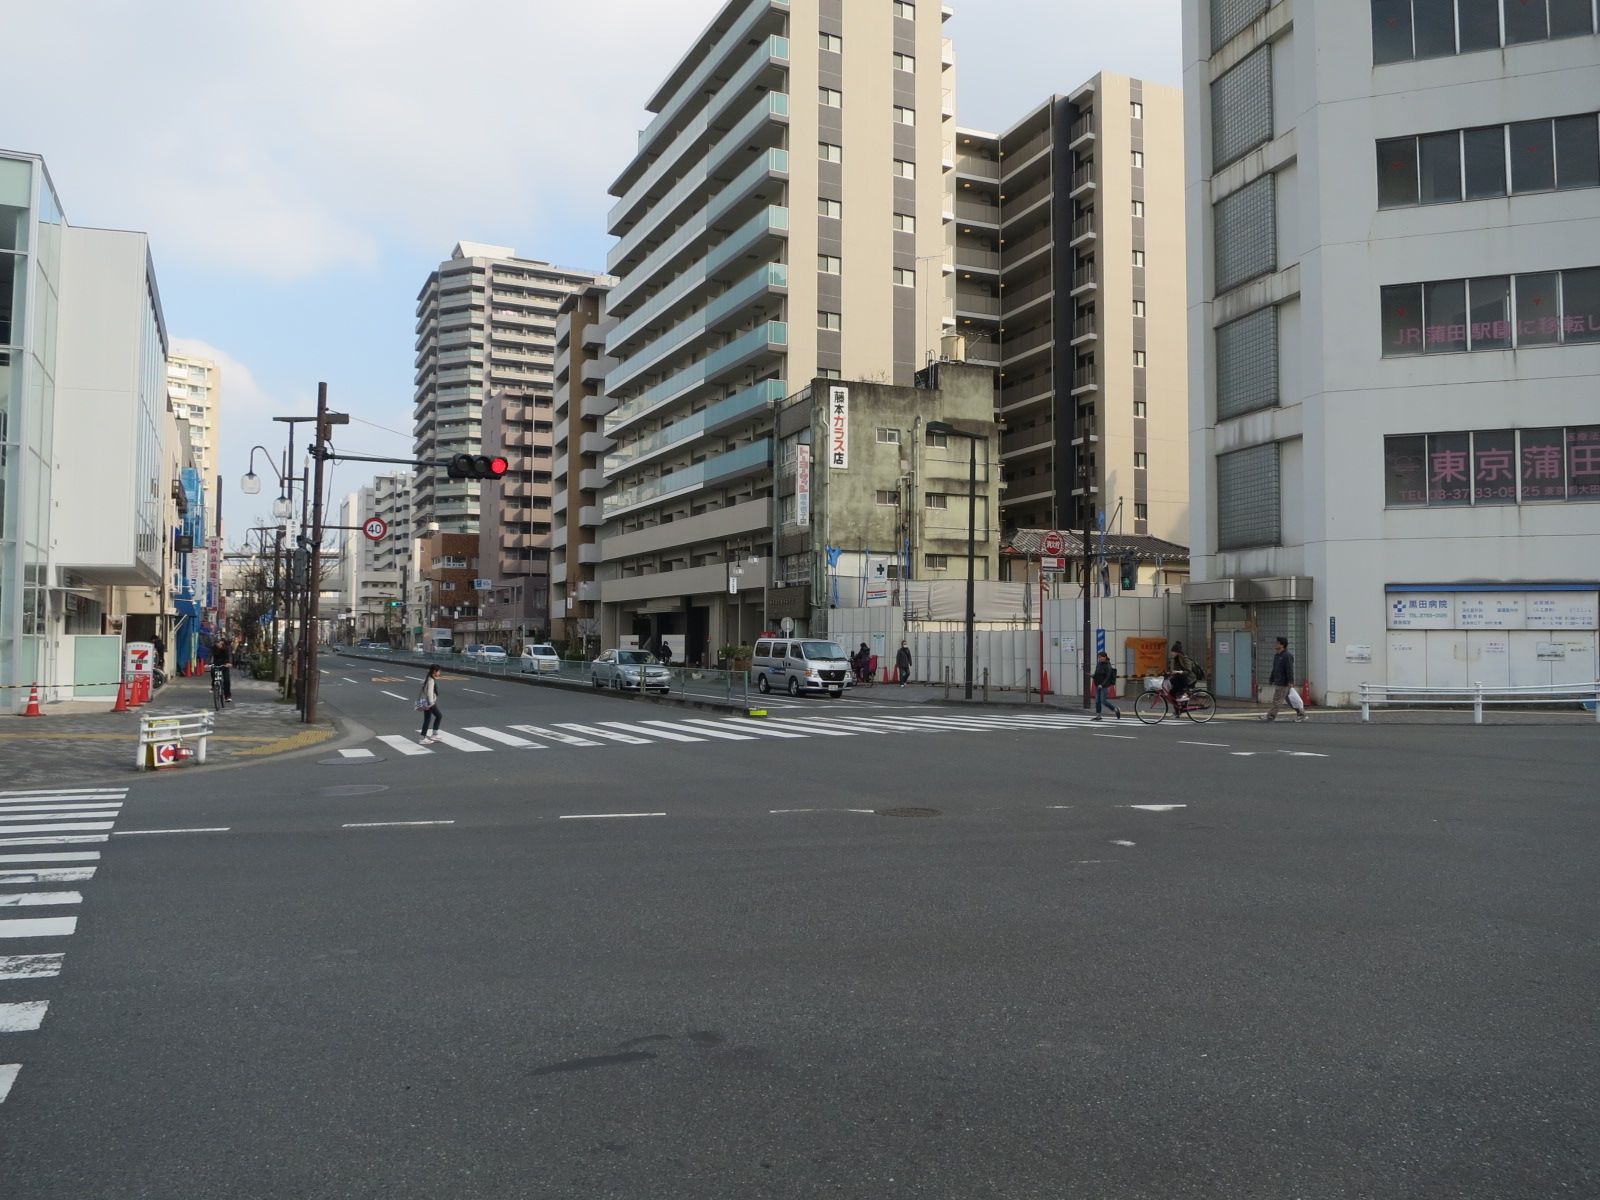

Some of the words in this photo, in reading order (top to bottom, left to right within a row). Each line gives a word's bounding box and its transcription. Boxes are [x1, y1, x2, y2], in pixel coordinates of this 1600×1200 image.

[833, 391, 846, 465] 藤本ガラス店
[1430, 444, 1600, 483] 東京蒲田
[368, 523, 382, 535] 40
[1408, 600, 1448, 609] 黒田病院
